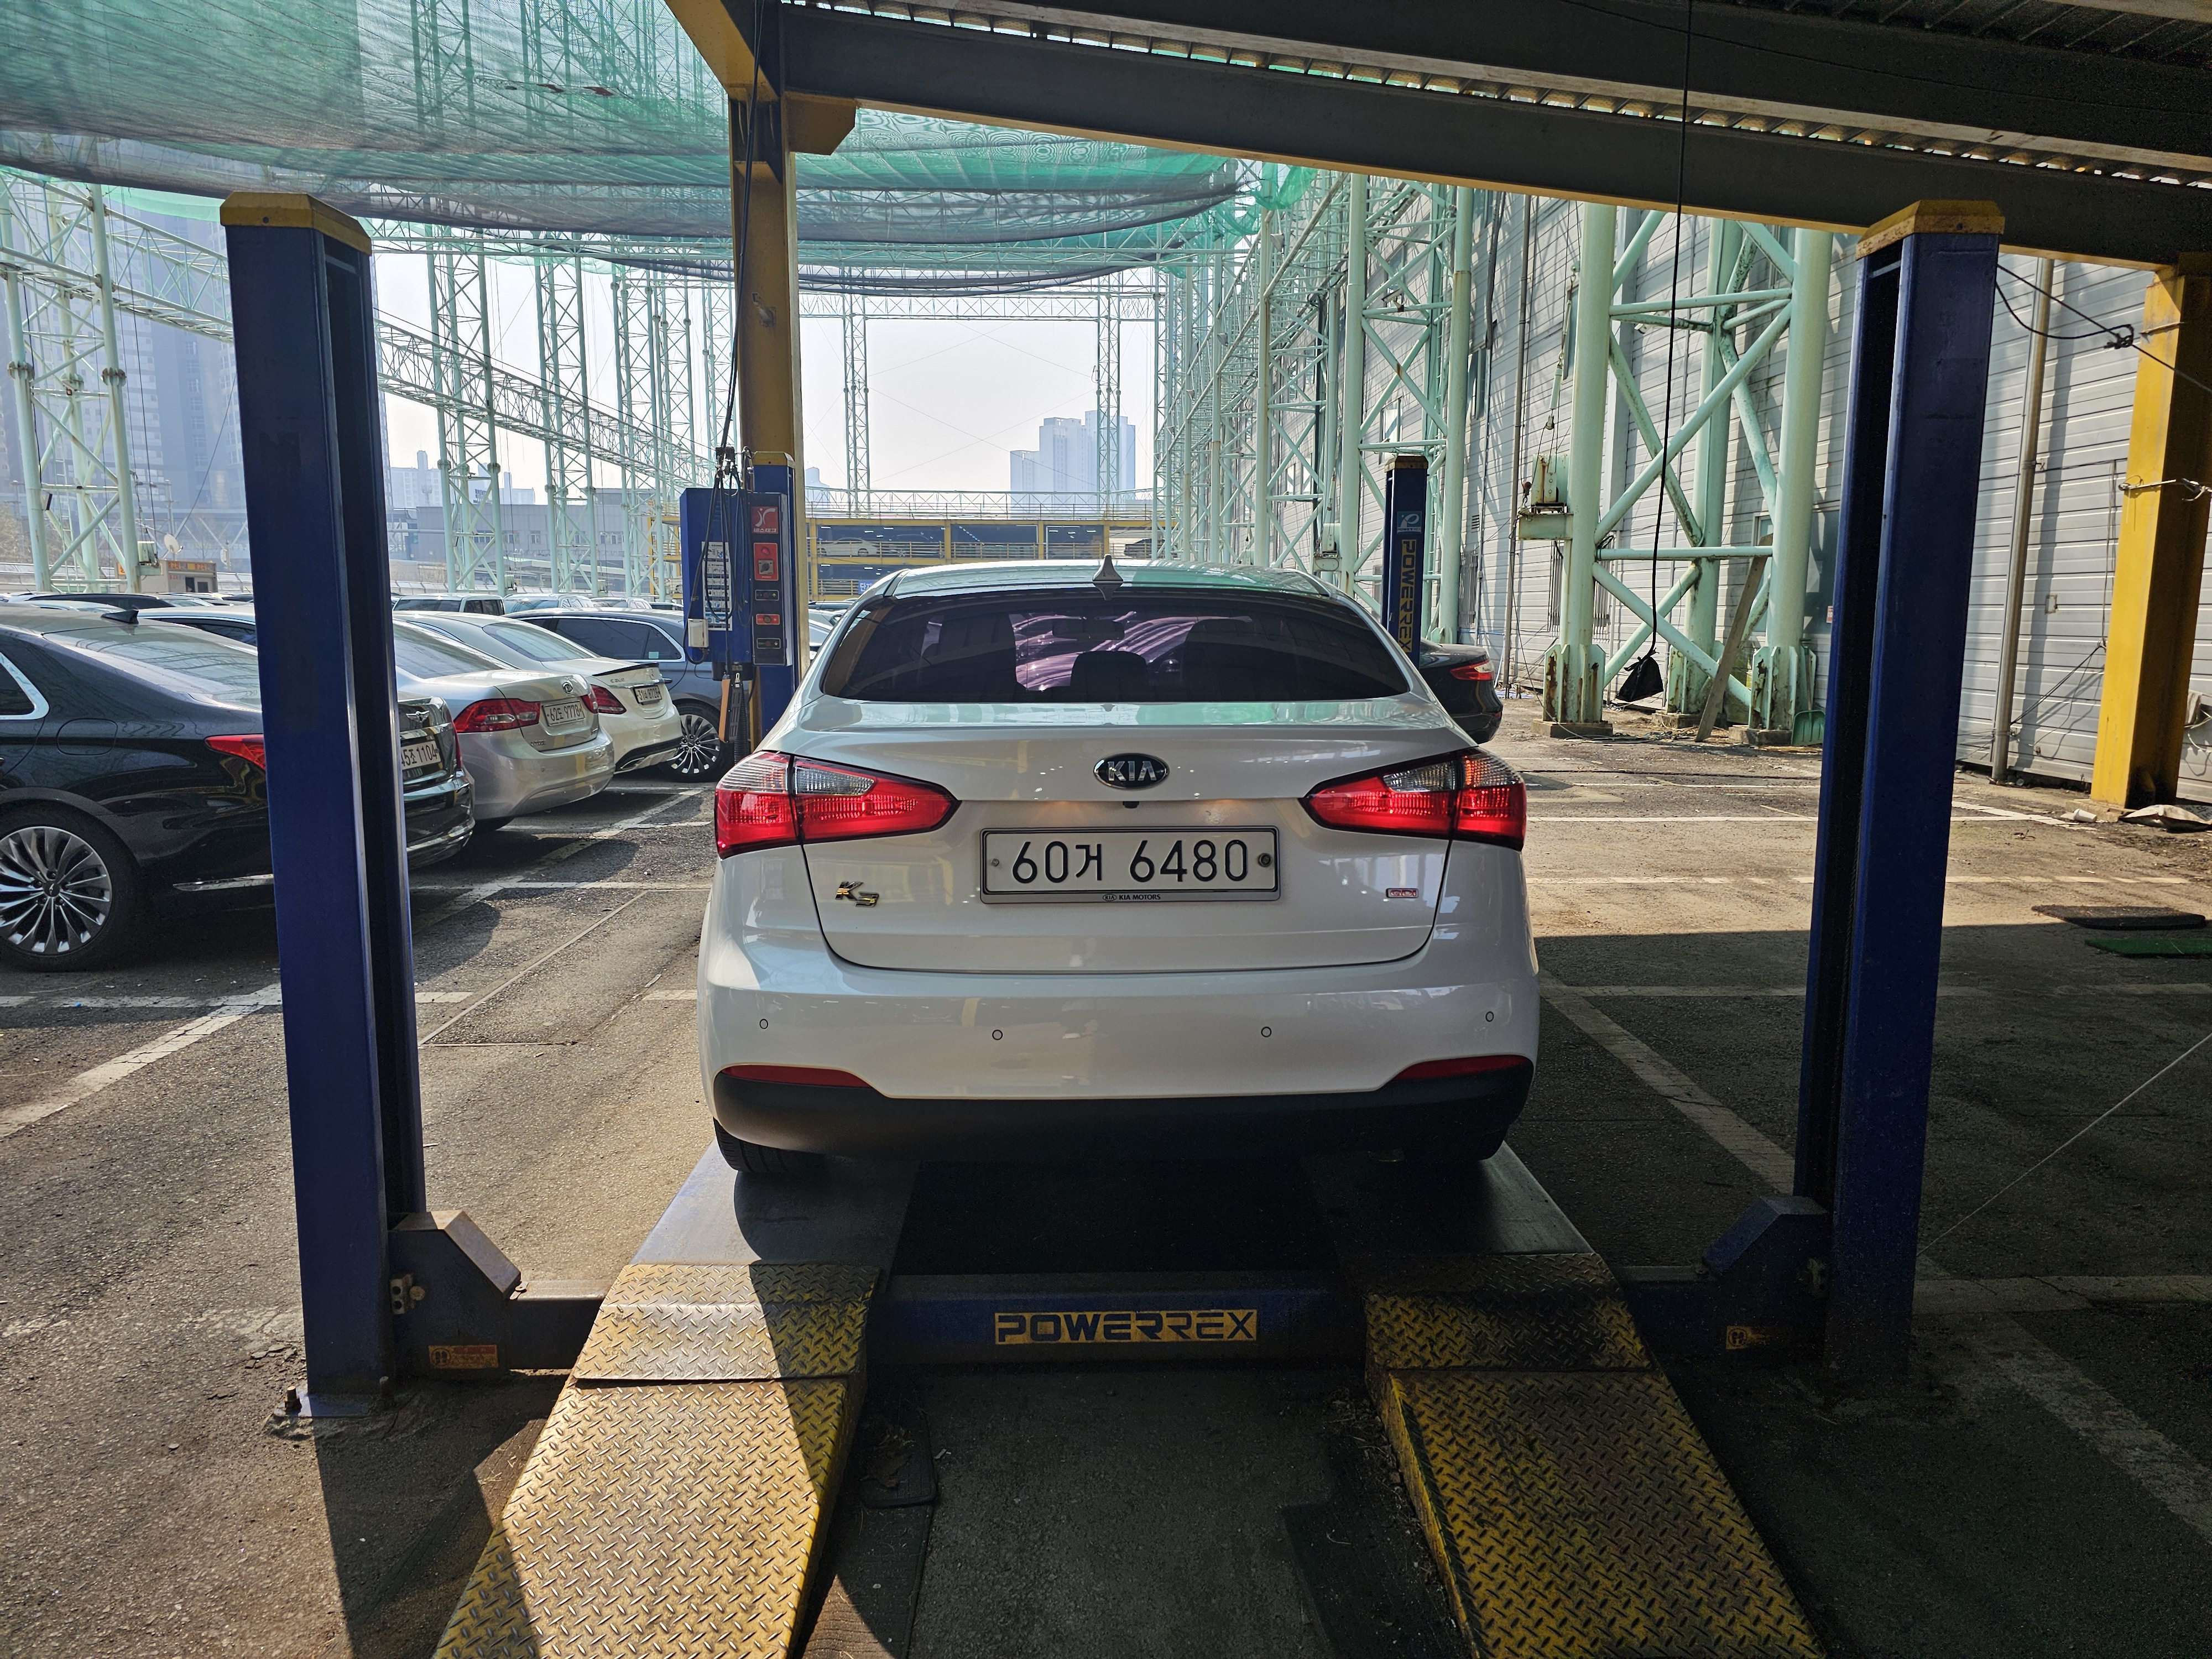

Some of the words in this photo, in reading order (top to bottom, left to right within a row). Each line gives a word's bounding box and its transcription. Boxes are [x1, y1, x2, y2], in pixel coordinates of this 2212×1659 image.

[1399, 540, 1416, 651] POWERREX
[564, 704, 580, 719] 9778
[416, 744, 437, 763] 1104
[1107, 761, 1158, 781] KIA
[1012, 841, 1102, 884] 60거
[1130, 839, 1248, 883] 6480
[835, 881, 879, 907] K3
[998, 1311, 1254, 1342] POWERREX
